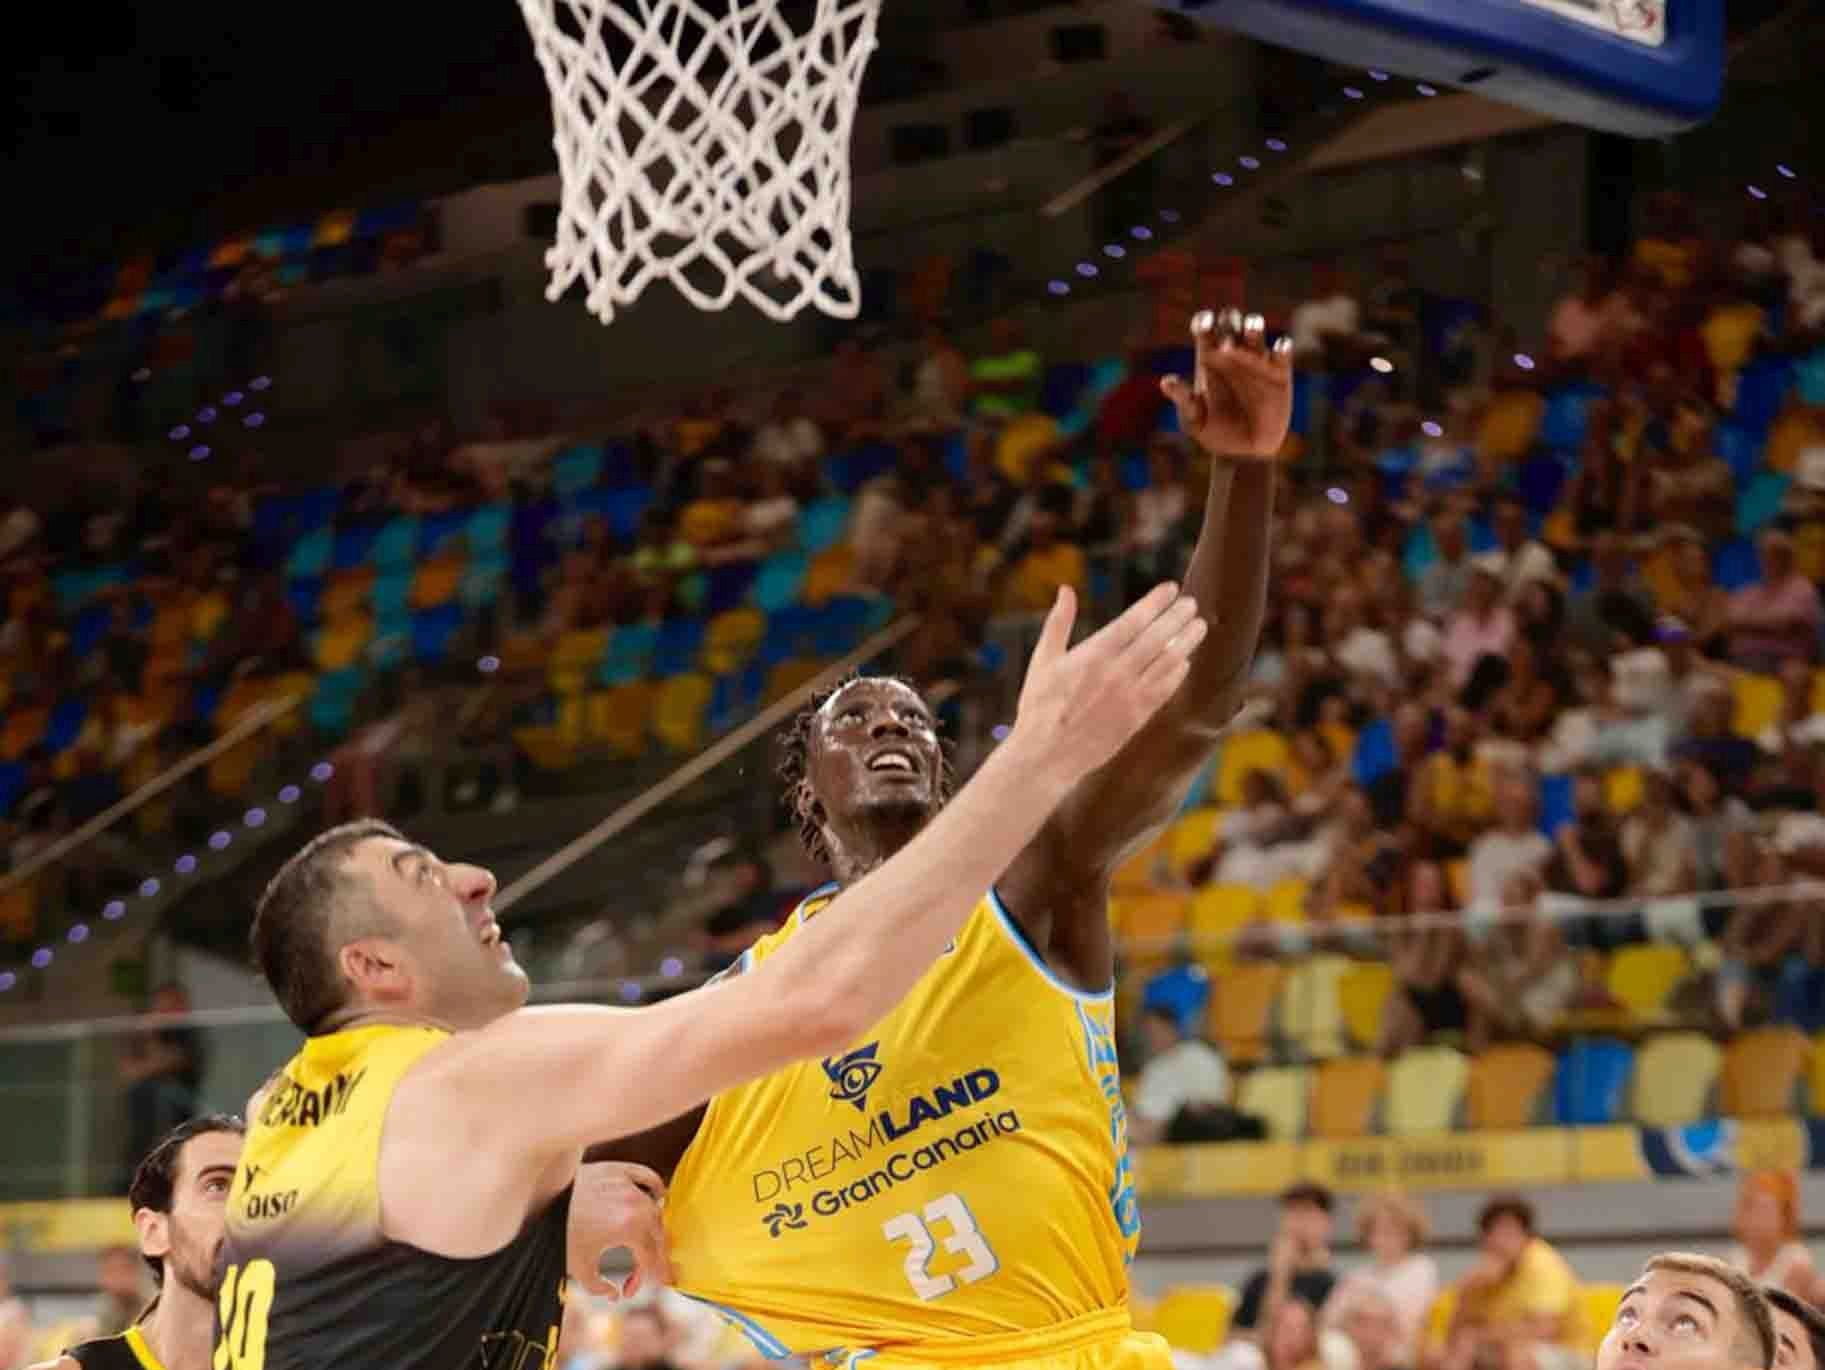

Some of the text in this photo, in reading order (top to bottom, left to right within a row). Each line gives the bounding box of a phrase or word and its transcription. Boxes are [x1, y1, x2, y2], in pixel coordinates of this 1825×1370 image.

[752, 1067, 1001, 1204] DREAMLAND
[813, 1109, 1022, 1219] GranCanaria
[882, 1191, 1000, 1303] 23
